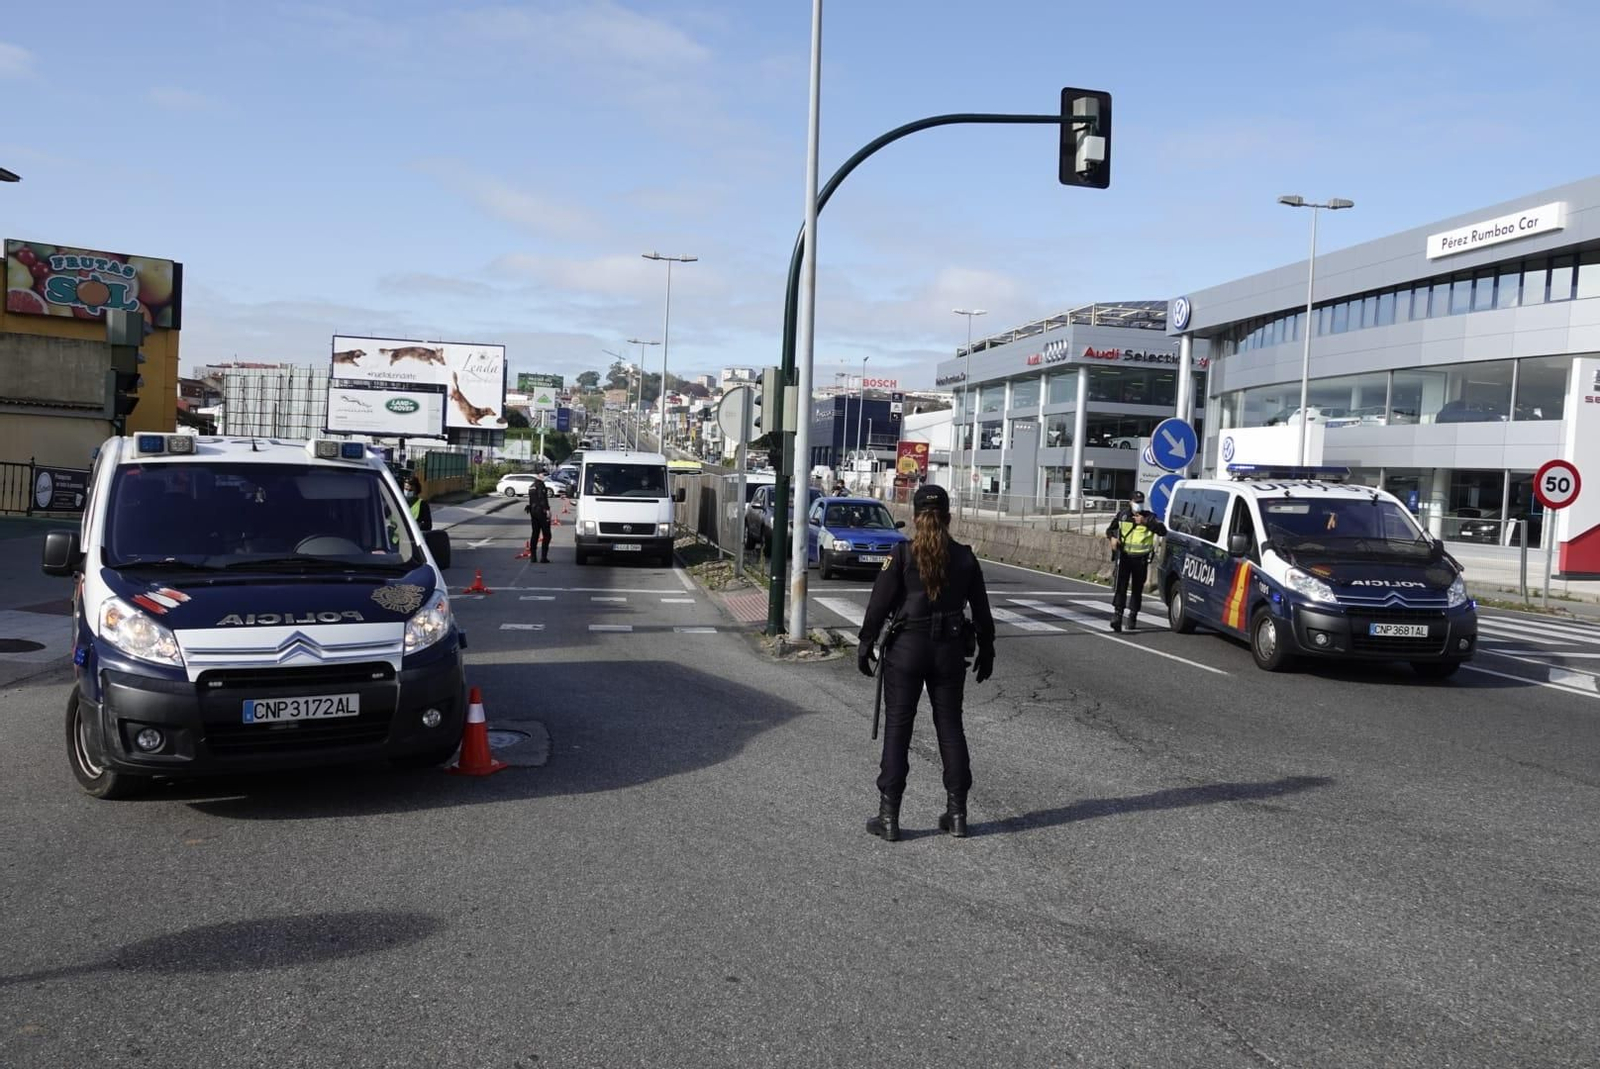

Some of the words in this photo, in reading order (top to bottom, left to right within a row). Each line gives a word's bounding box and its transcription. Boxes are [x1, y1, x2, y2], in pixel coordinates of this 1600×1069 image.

[1441, 236, 1468, 250] Pérez
[1471, 223, 1515, 243] Rumbao
[1518, 216, 1539, 231] Car
[50, 255, 136, 278] FRUTAS
[45, 273, 140, 315] SOL
[1083, 346, 1120, 360] Audi
[1124, 349, 1195, 365] Selecti
[862, 379, 897, 389] BOSCH
[1545, 475, 1571, 494] 50
[1182, 557, 1216, 587] POLICIA
[1373, 624, 1428, 637] CNP3681AL
[253, 696, 357, 720] CNP3172AL
